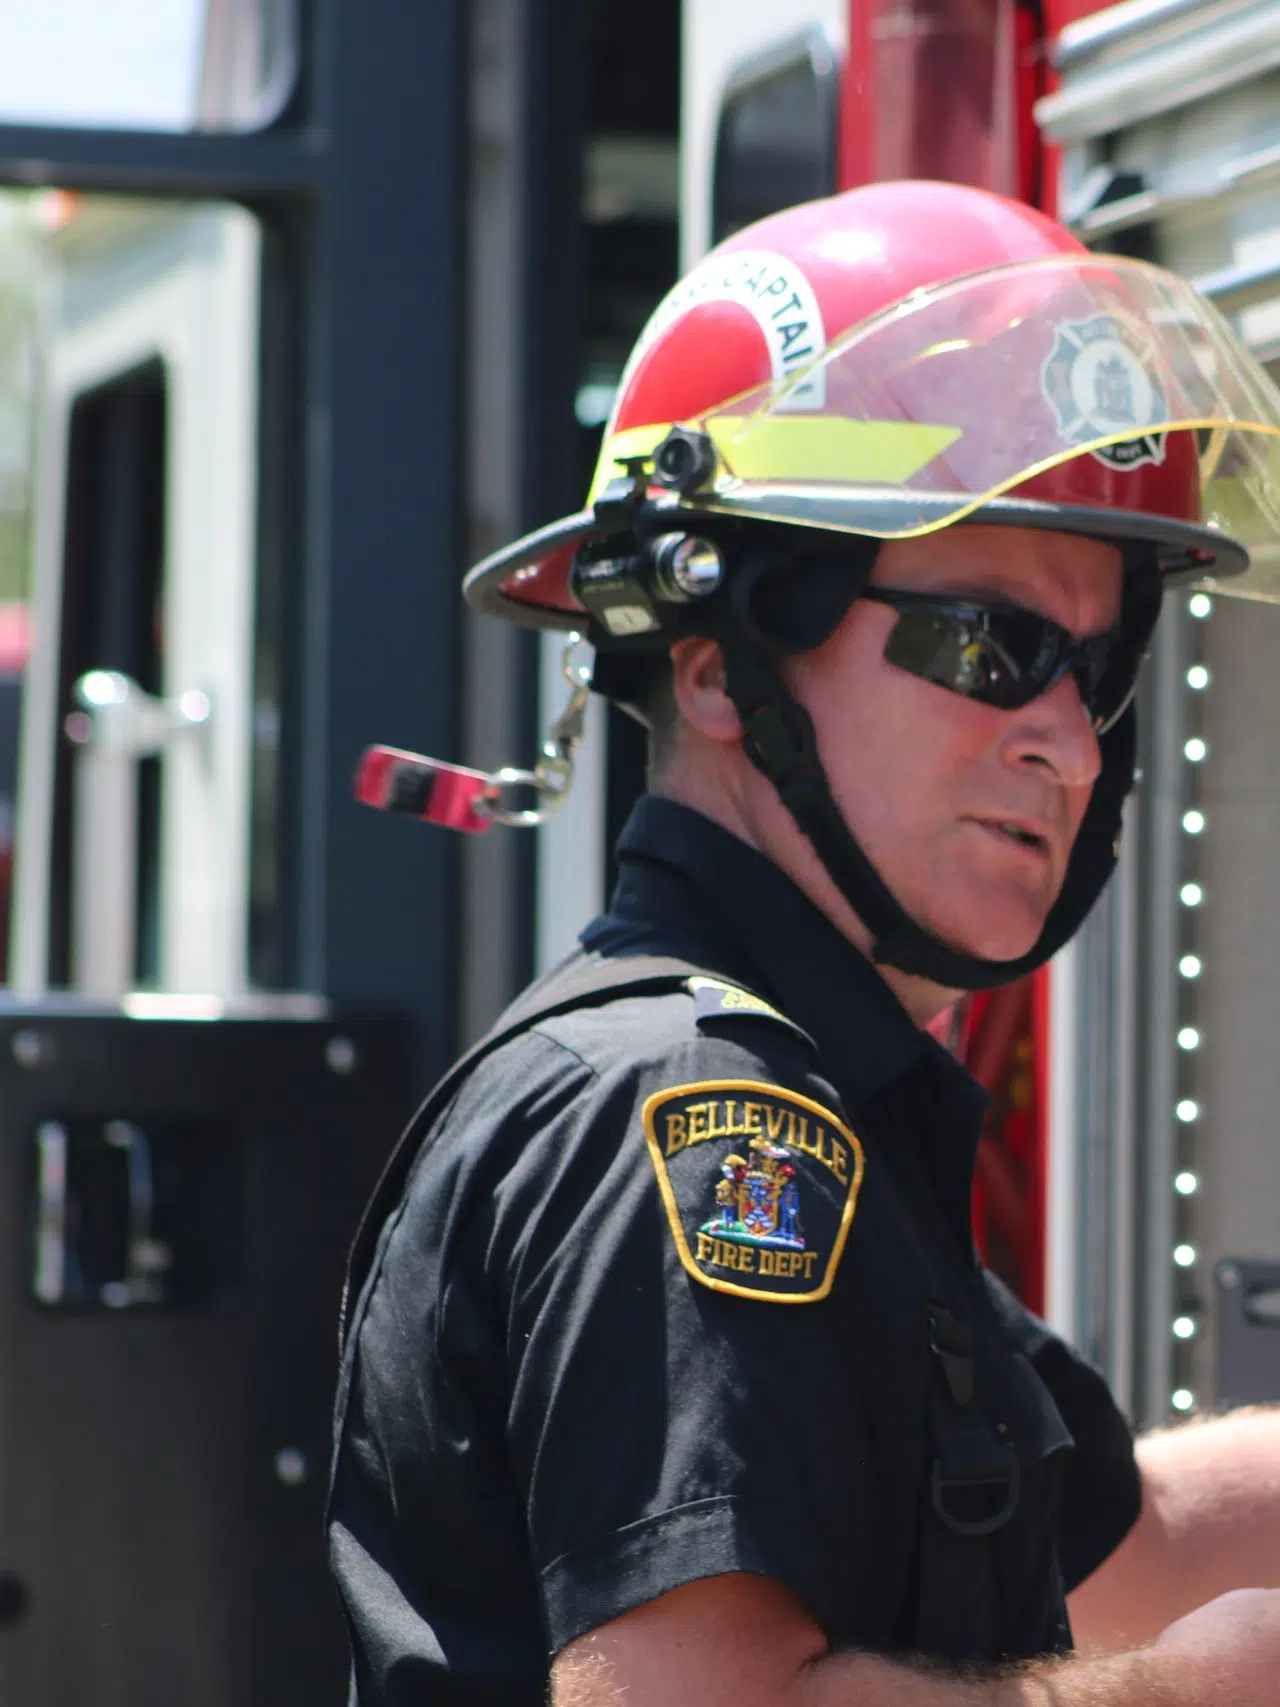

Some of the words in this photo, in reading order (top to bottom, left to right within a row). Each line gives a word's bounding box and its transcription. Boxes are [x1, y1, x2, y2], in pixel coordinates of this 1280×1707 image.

[665, 1100, 848, 1187] BELLEVILLE
[695, 1231, 755, 1274] FIRE
[758, 1247, 818, 1279] DEPT
